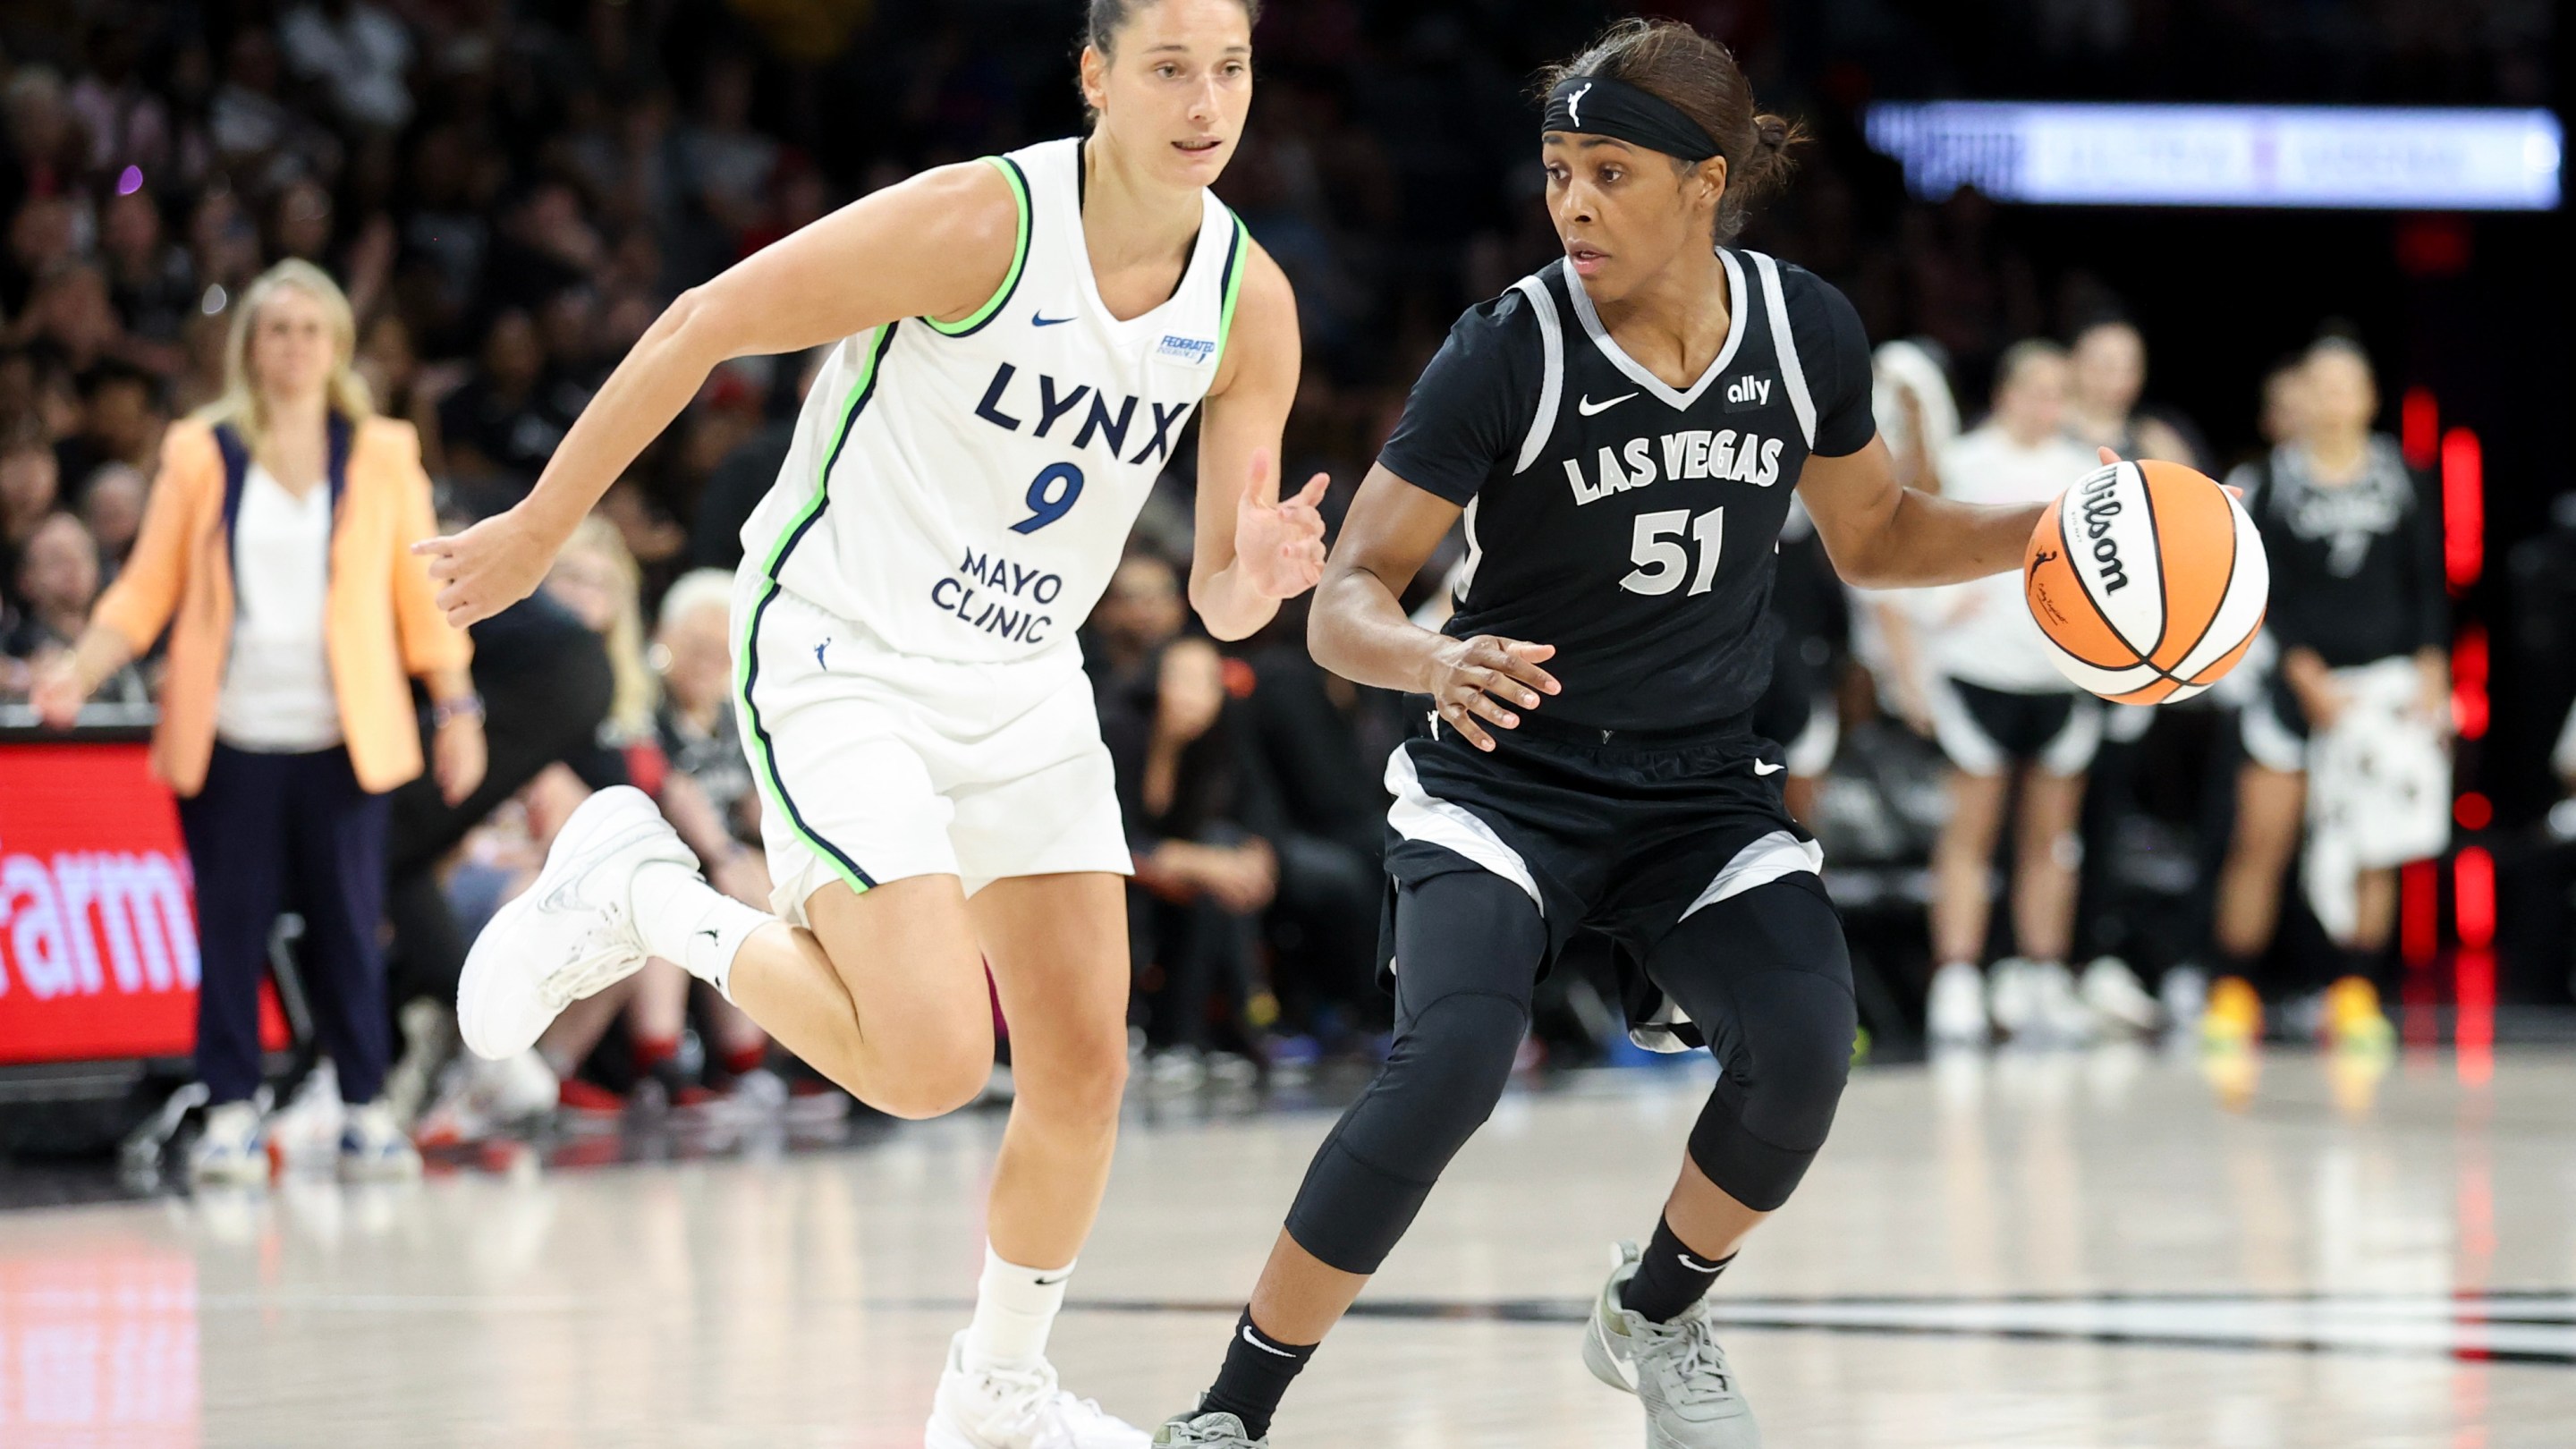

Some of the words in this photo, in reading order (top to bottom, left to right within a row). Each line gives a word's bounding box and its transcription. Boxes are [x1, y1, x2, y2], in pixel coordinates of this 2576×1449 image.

[1161, 335, 1215, 352] FEDERATED
[974, 361, 1191, 465] LYNX
[1727, 375, 1772, 406] ally
[1008, 462, 1085, 535] 9
[1563, 437, 1657, 506] LAS
[1660, 428, 1784, 487] VEGAS
[1619, 505, 1724, 597] 51
[2080, 465, 2129, 597] Wilson
[931, 577, 1053, 644] CLINIC
[960, 546, 1063, 605] MAYO
[0, 848, 203, 1002] arm
